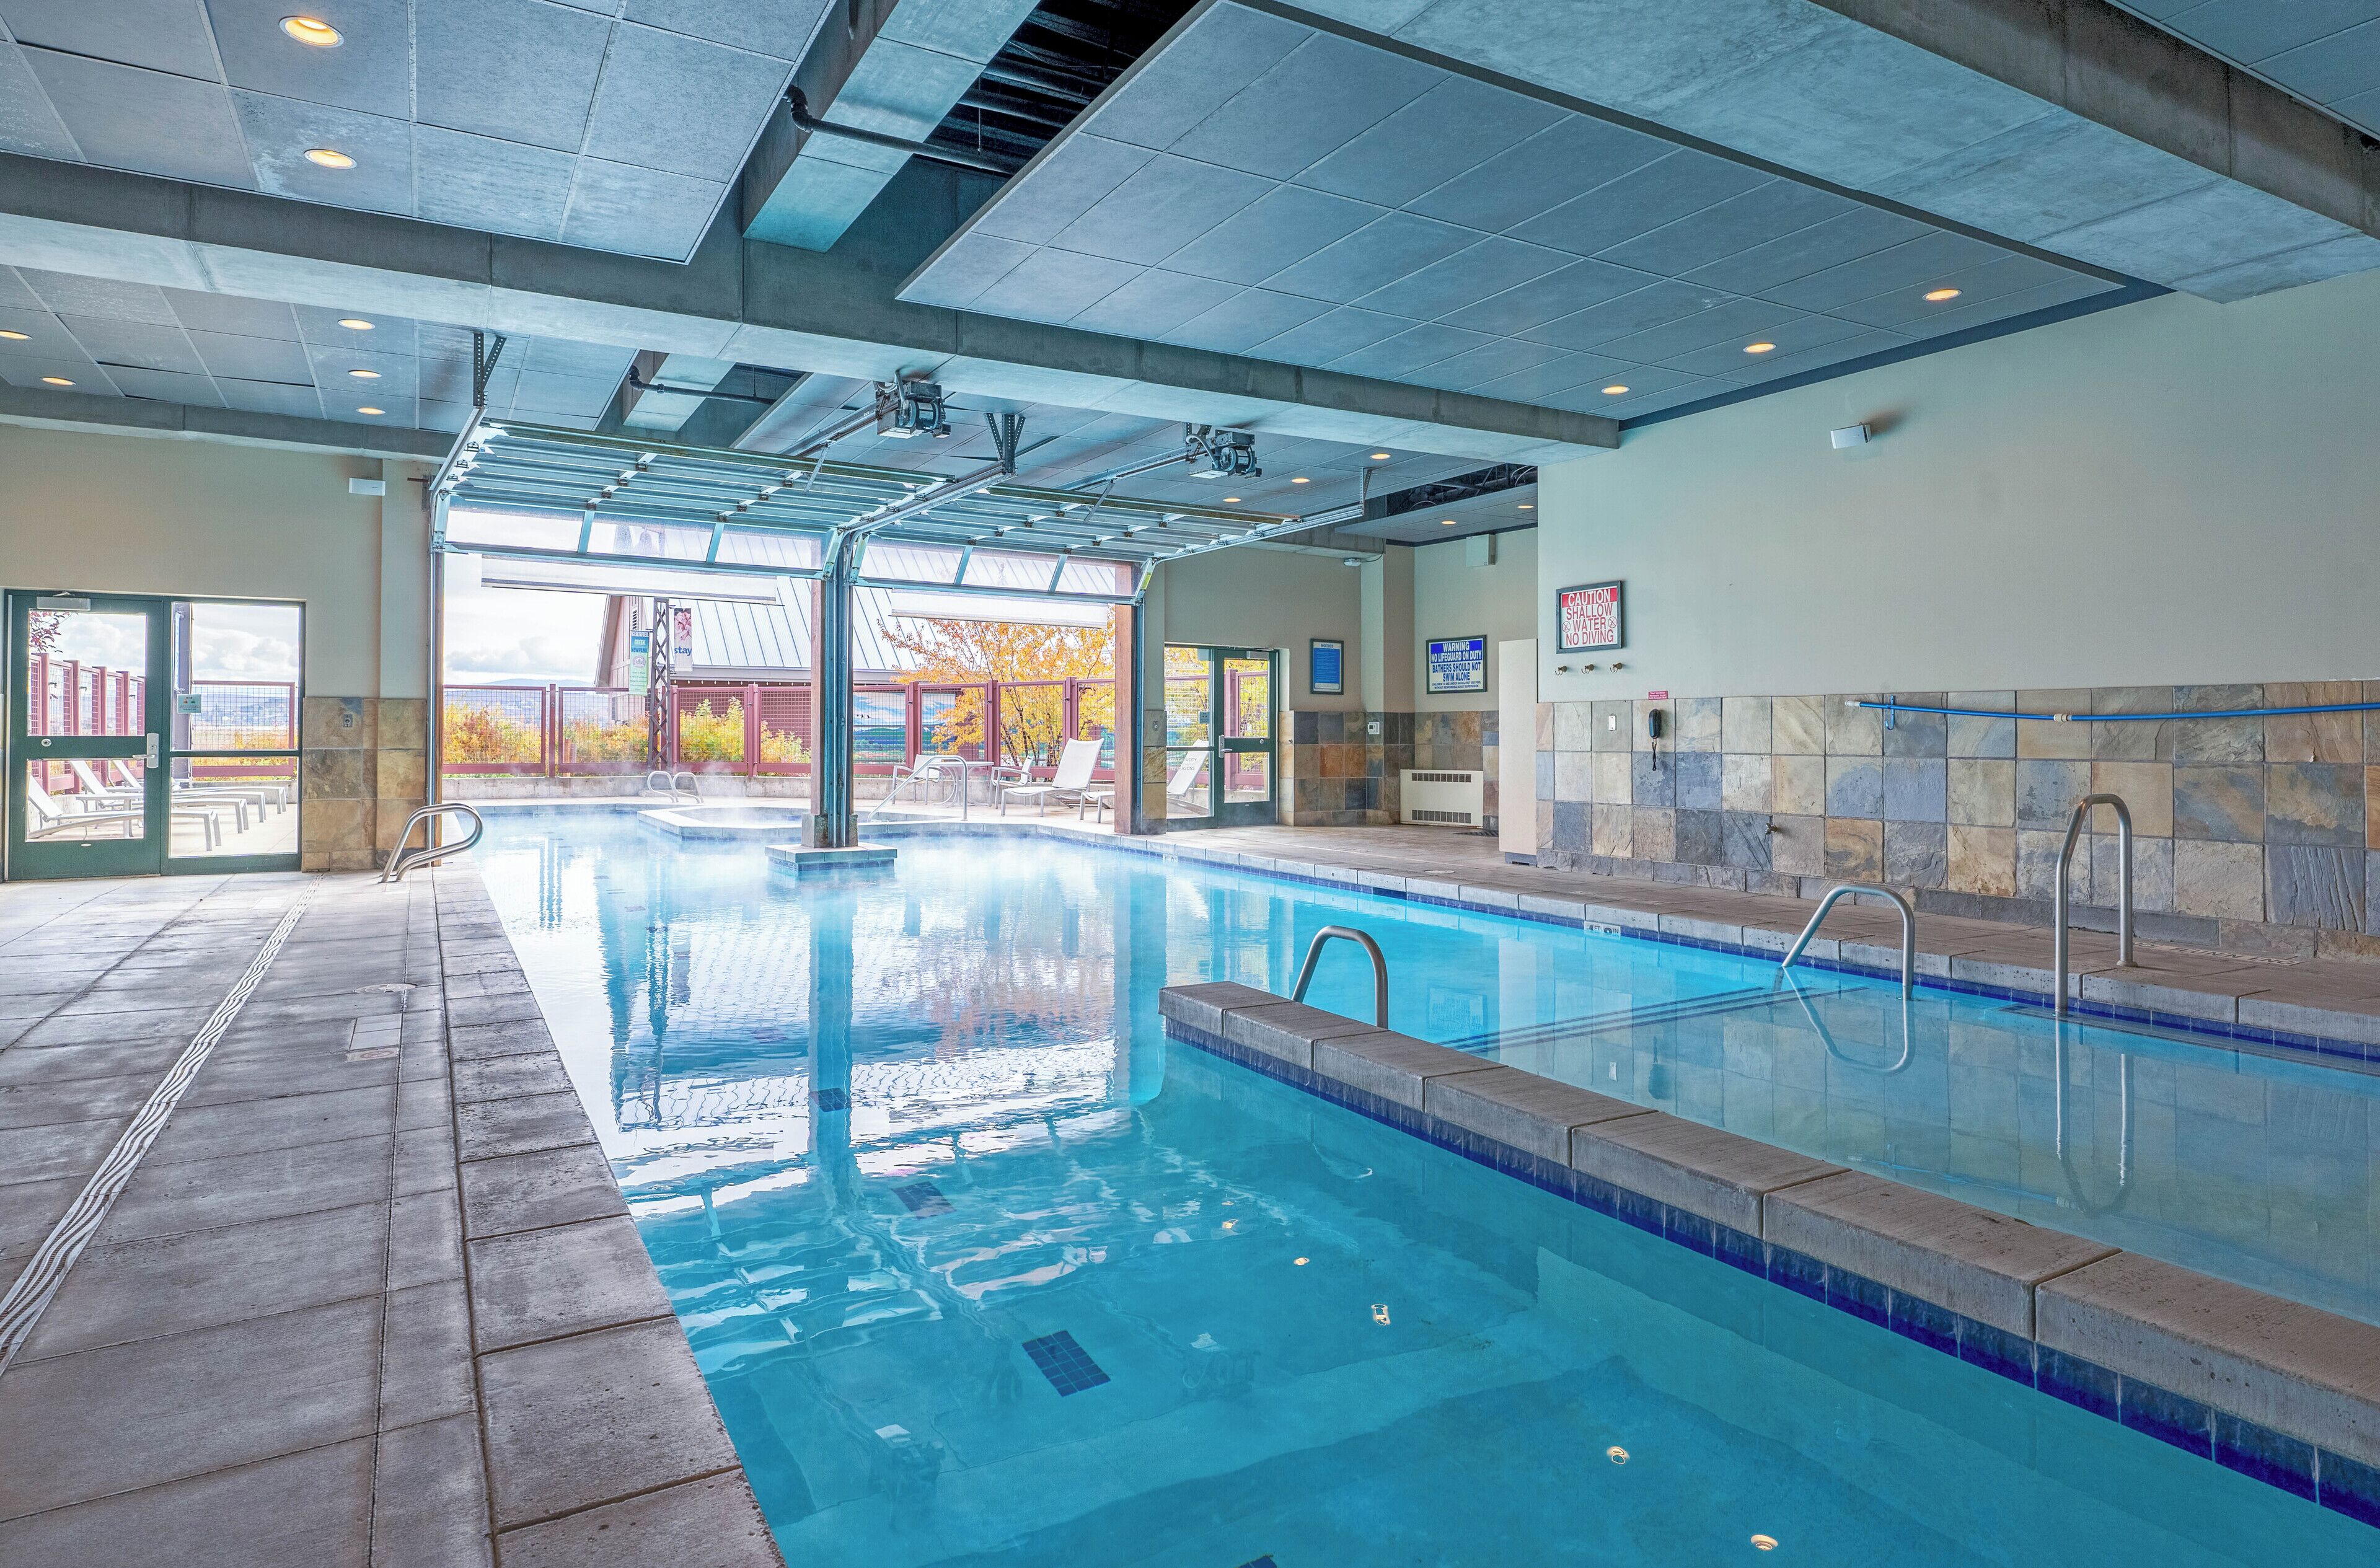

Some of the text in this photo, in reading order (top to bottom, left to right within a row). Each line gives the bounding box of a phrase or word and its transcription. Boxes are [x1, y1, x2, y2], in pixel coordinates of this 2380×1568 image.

[1568, 589, 1611, 606] CAUTION
[1566, 603, 1613, 620] SHALLOW
[1573, 617, 1606, 632] WATER
[1566, 629, 1613, 646] NO DIVING
[674, 646, 692, 656] stay
[1443, 641, 1470, 652] WARNING
[1431, 650, 1482, 663] NO LIFEGUARD ON DUTY
[1432, 661, 1481, 673] BATHERS SHOULD NOT
[1443, 672, 1470, 682] SWIM ALONE
[2169, 948, 2296, 965] RUNNING
